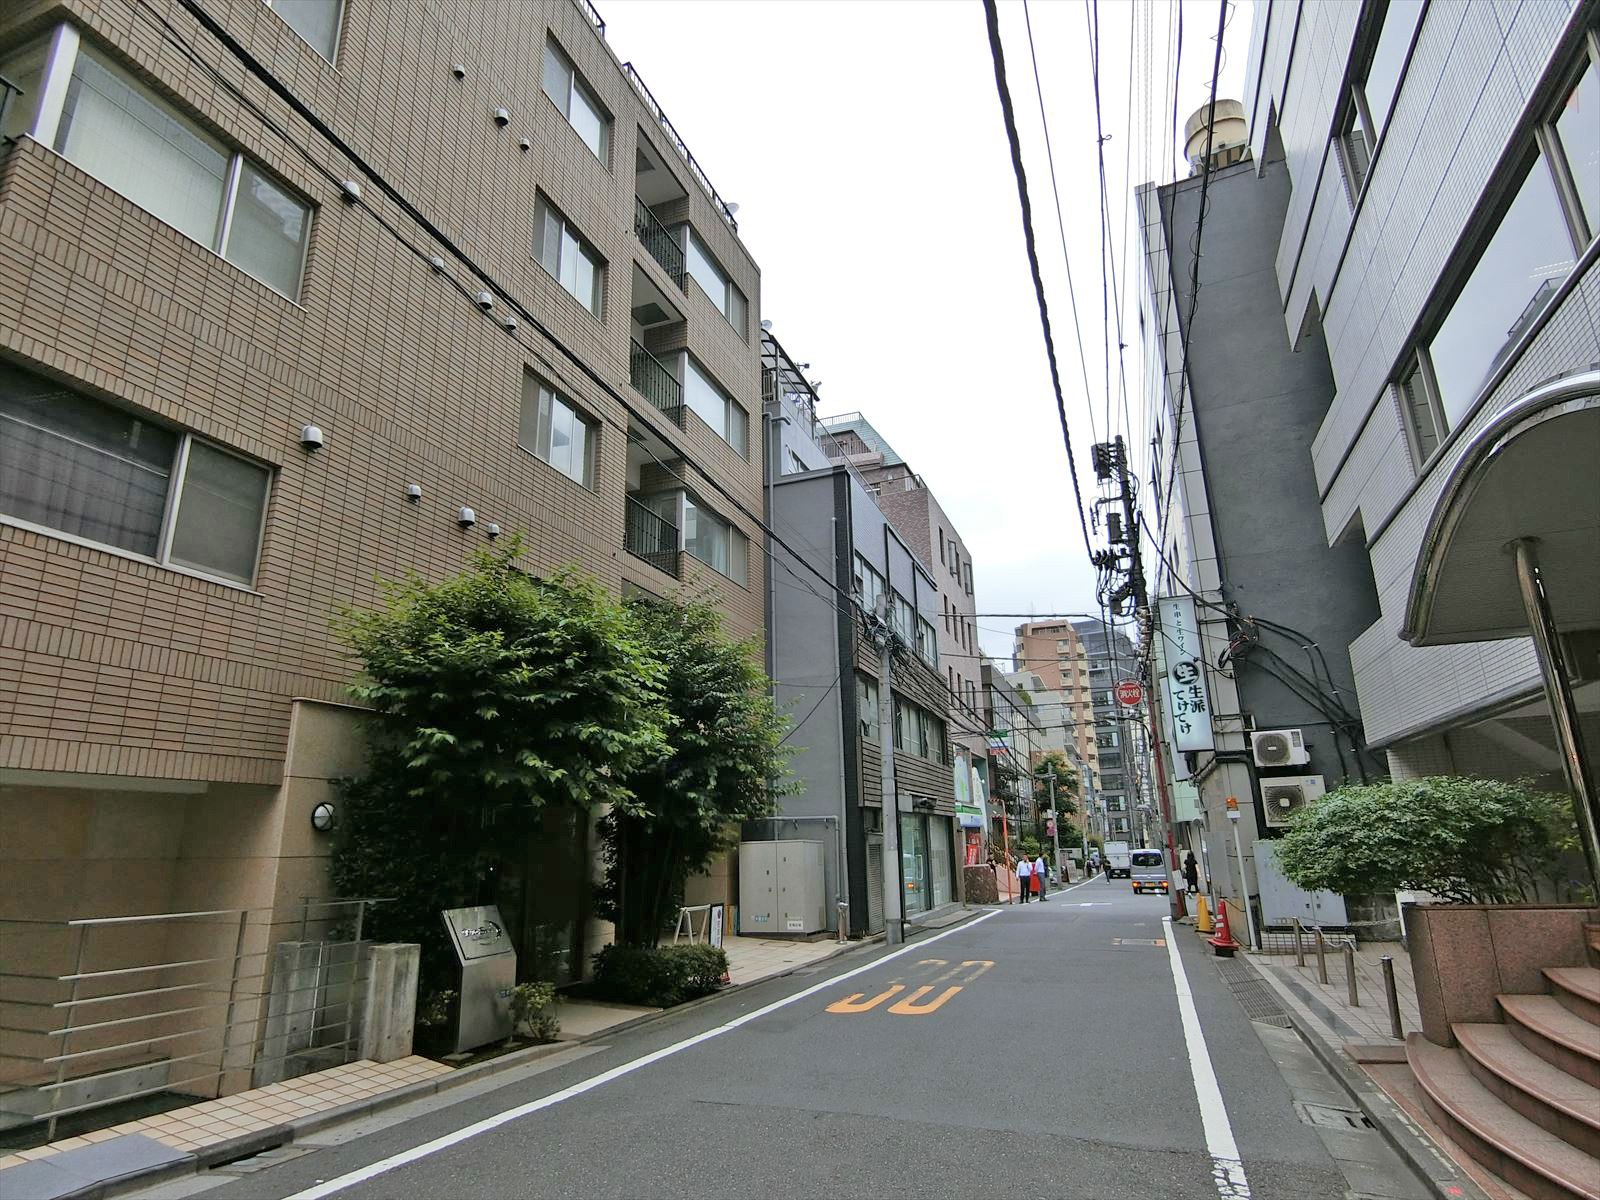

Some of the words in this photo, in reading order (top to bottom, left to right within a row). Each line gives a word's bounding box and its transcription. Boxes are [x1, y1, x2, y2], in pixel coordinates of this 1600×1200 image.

[1176, 664, 1198, 684] 生
[1119, 688, 1140, 699] 消火栓
[1188, 685, 1206, 714] 生派
[1172, 690, 1192, 735] てけてけ
